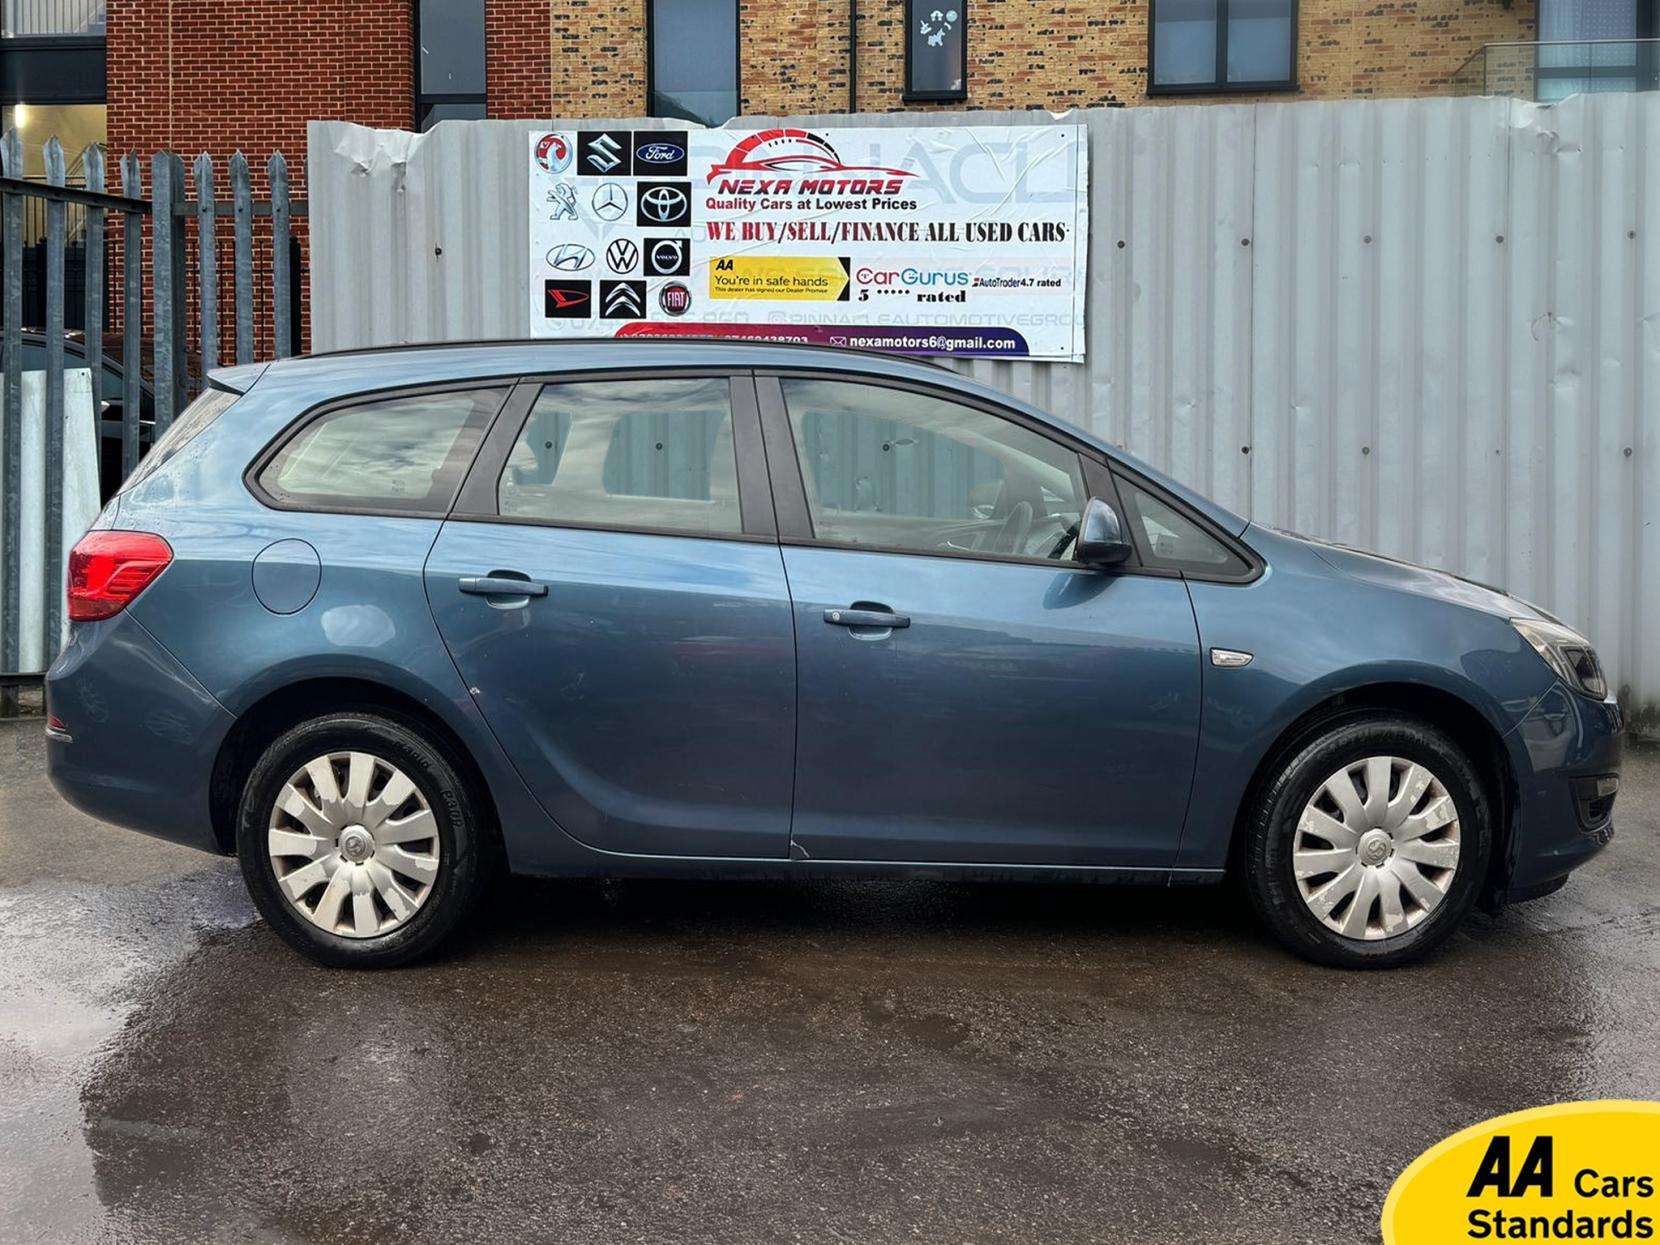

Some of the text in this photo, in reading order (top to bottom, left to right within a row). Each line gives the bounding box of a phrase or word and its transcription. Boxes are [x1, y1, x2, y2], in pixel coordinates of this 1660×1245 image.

[645, 144, 675, 160] Ford
[717, 179, 904, 195] NEXA MOTORS
[705, 197, 918, 212] Quality Cars at Lowest Prices
[706, 221, 1067, 244] WE BUY/SELL/FINANCE ALL USED CARS
[716, 259, 734, 271] AA
[714, 275, 829, 287] You're in safe hands
[857, 267, 970, 286] CarGurus
[1036, 278, 1062, 288] rated
[667, 291, 686, 307] FIAT
[858, 289, 967, 302] 5 rated
[850, 336, 1016, 351] nexamotors6@gmail.com
